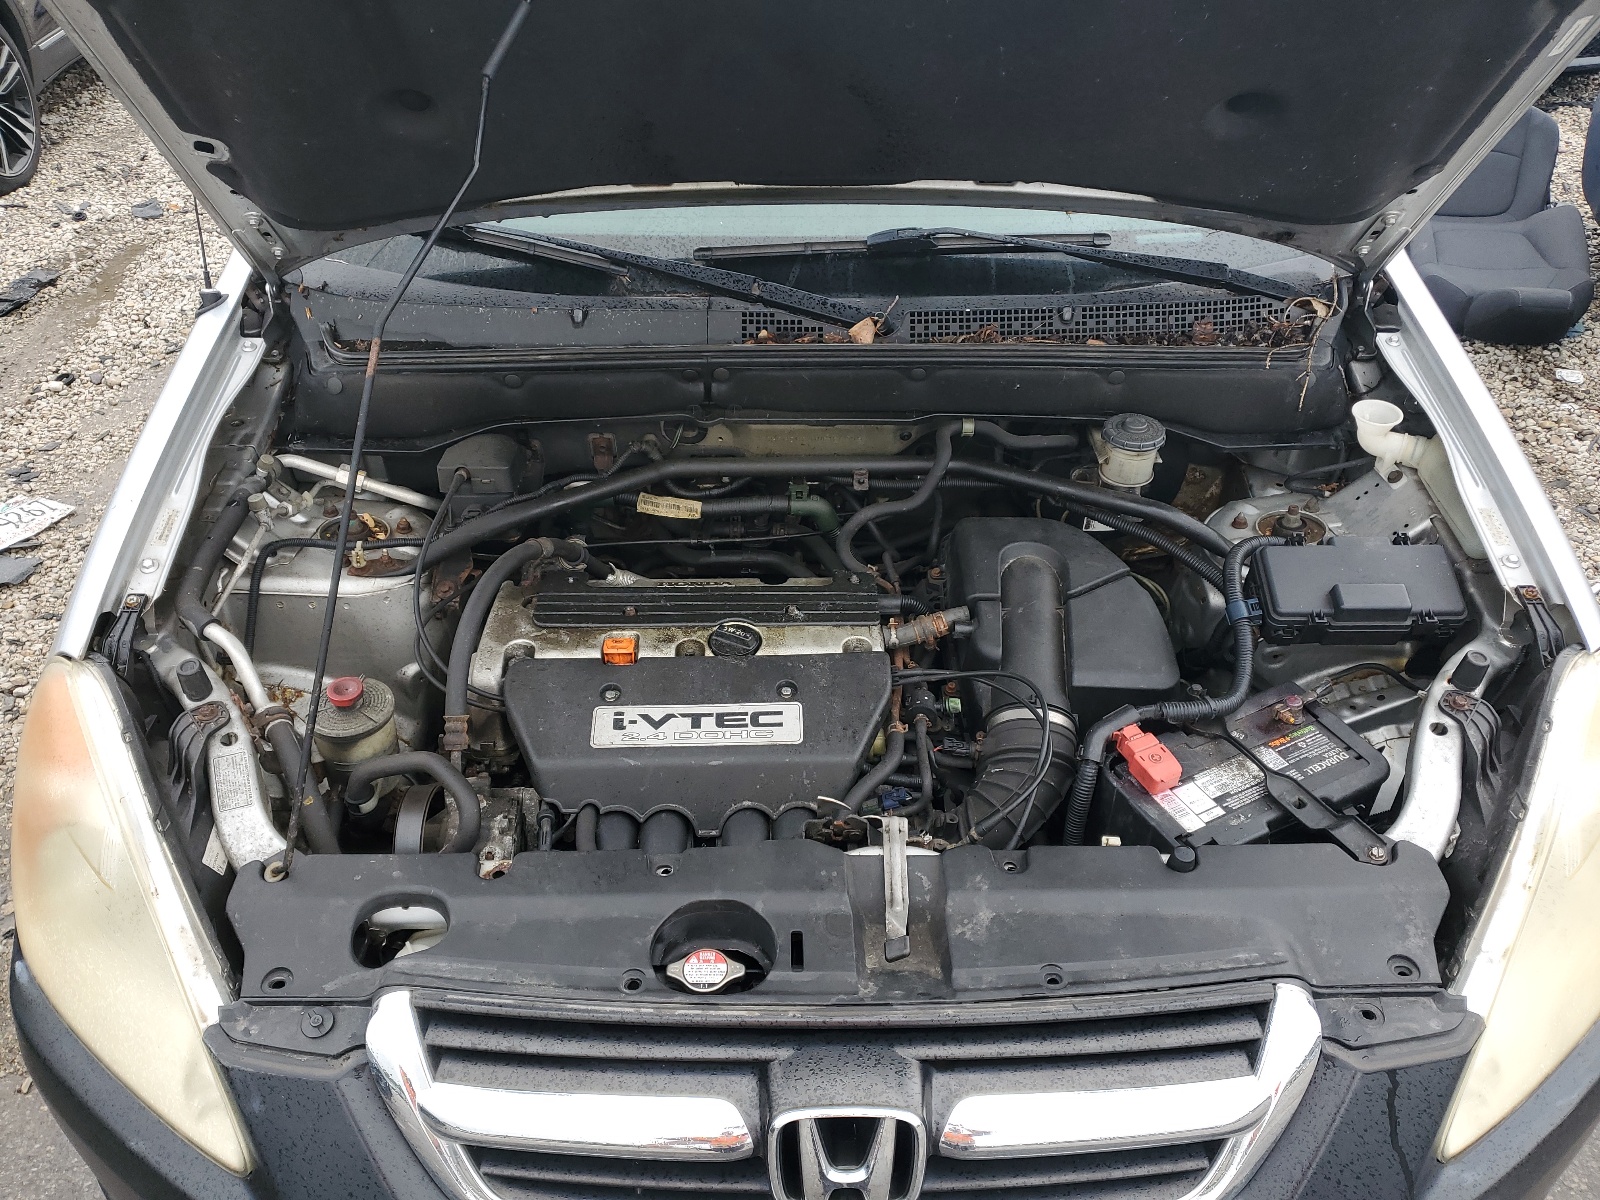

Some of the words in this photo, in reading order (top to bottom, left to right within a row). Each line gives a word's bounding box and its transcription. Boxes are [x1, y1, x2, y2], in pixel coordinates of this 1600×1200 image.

[612, 711, 784, 731] i-VTEC
[621, 731, 668, 742] 2.4
[673, 729, 774, 741] DOHC
[1321, 747, 1344, 758] ULTRA
[1302, 750, 1351, 776] DURACELL
